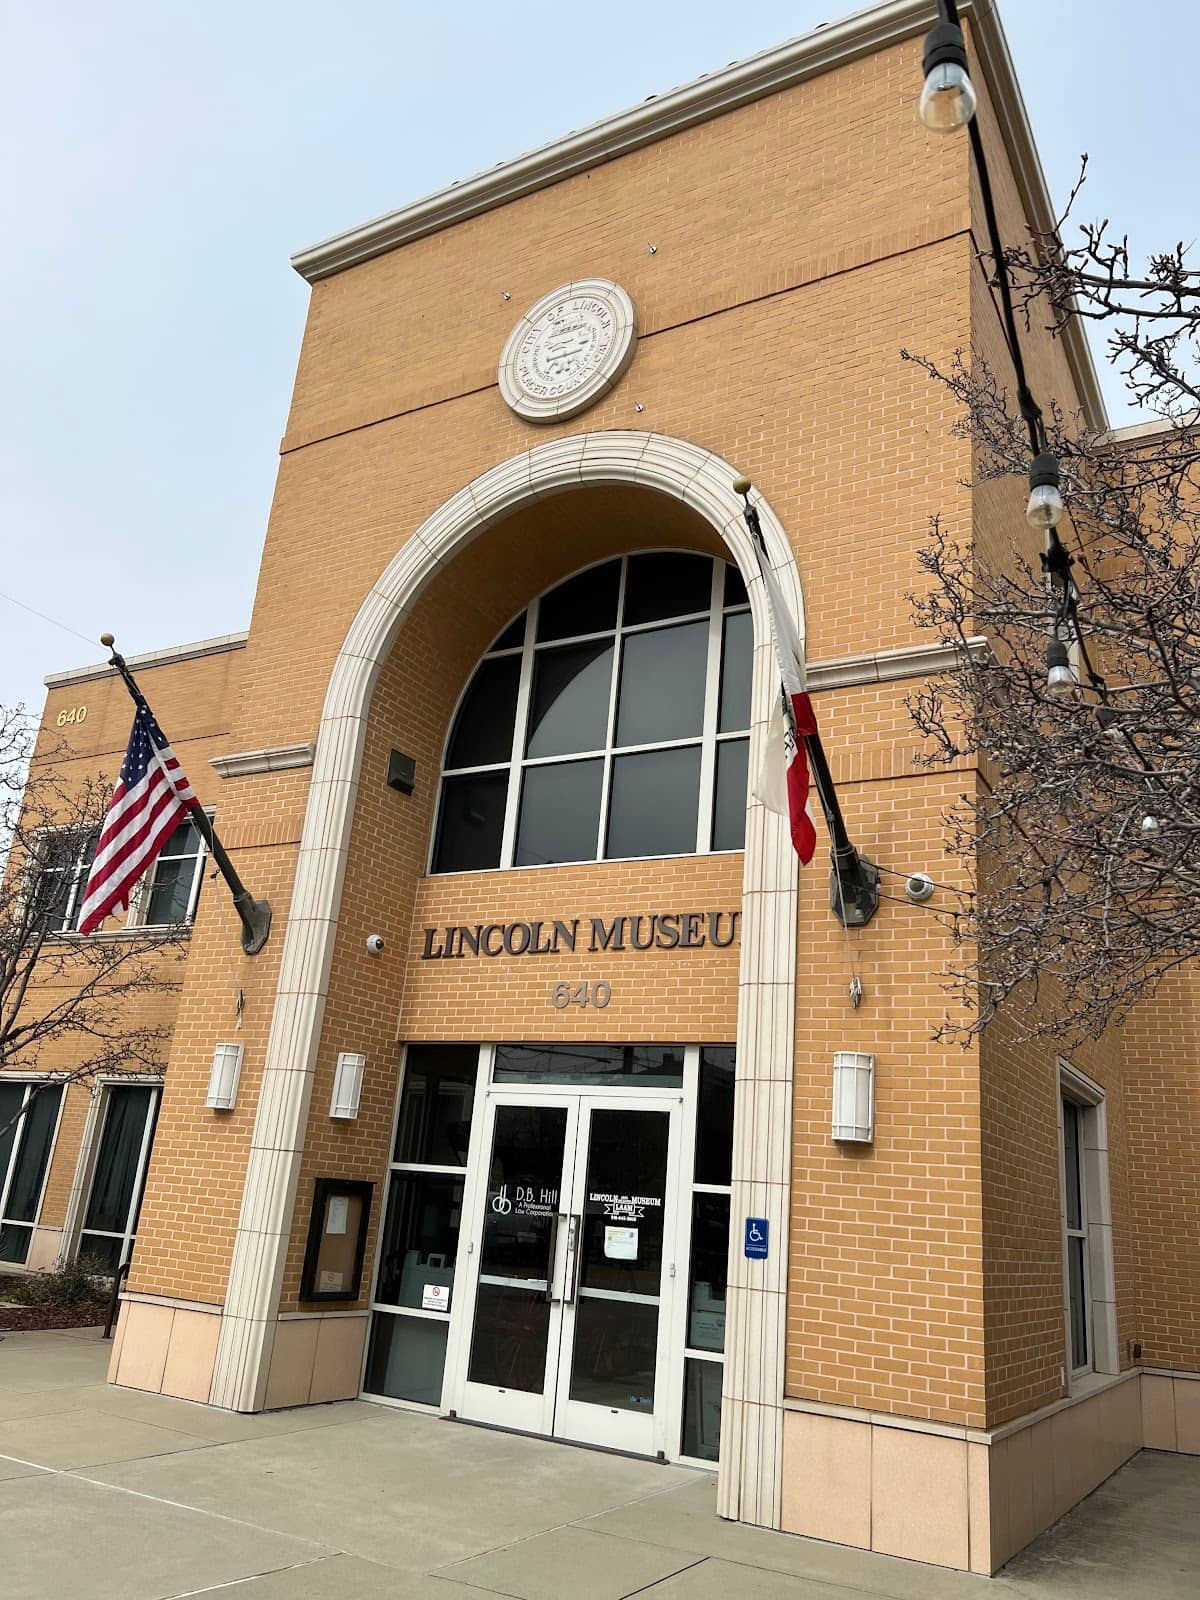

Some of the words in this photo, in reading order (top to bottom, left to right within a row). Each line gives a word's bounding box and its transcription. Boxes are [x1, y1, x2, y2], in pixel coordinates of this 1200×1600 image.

[522, 328, 542, 354] CITY
[547, 305, 564, 322] OF
[572, 299, 612, 330] LINCOLN
[56, 705, 87, 727] 640
[421, 918, 579, 960] LINCOLN
[588, 911, 742, 952] MUSEU
[551, 981, 612, 1009] 640
[516, 1186, 536, 1203] D.B.
[540, 1188, 558, 1205] Hill
[589, 1192, 619, 1203] LINCOLN
[631, 1195, 662, 1207] MUSEUM
